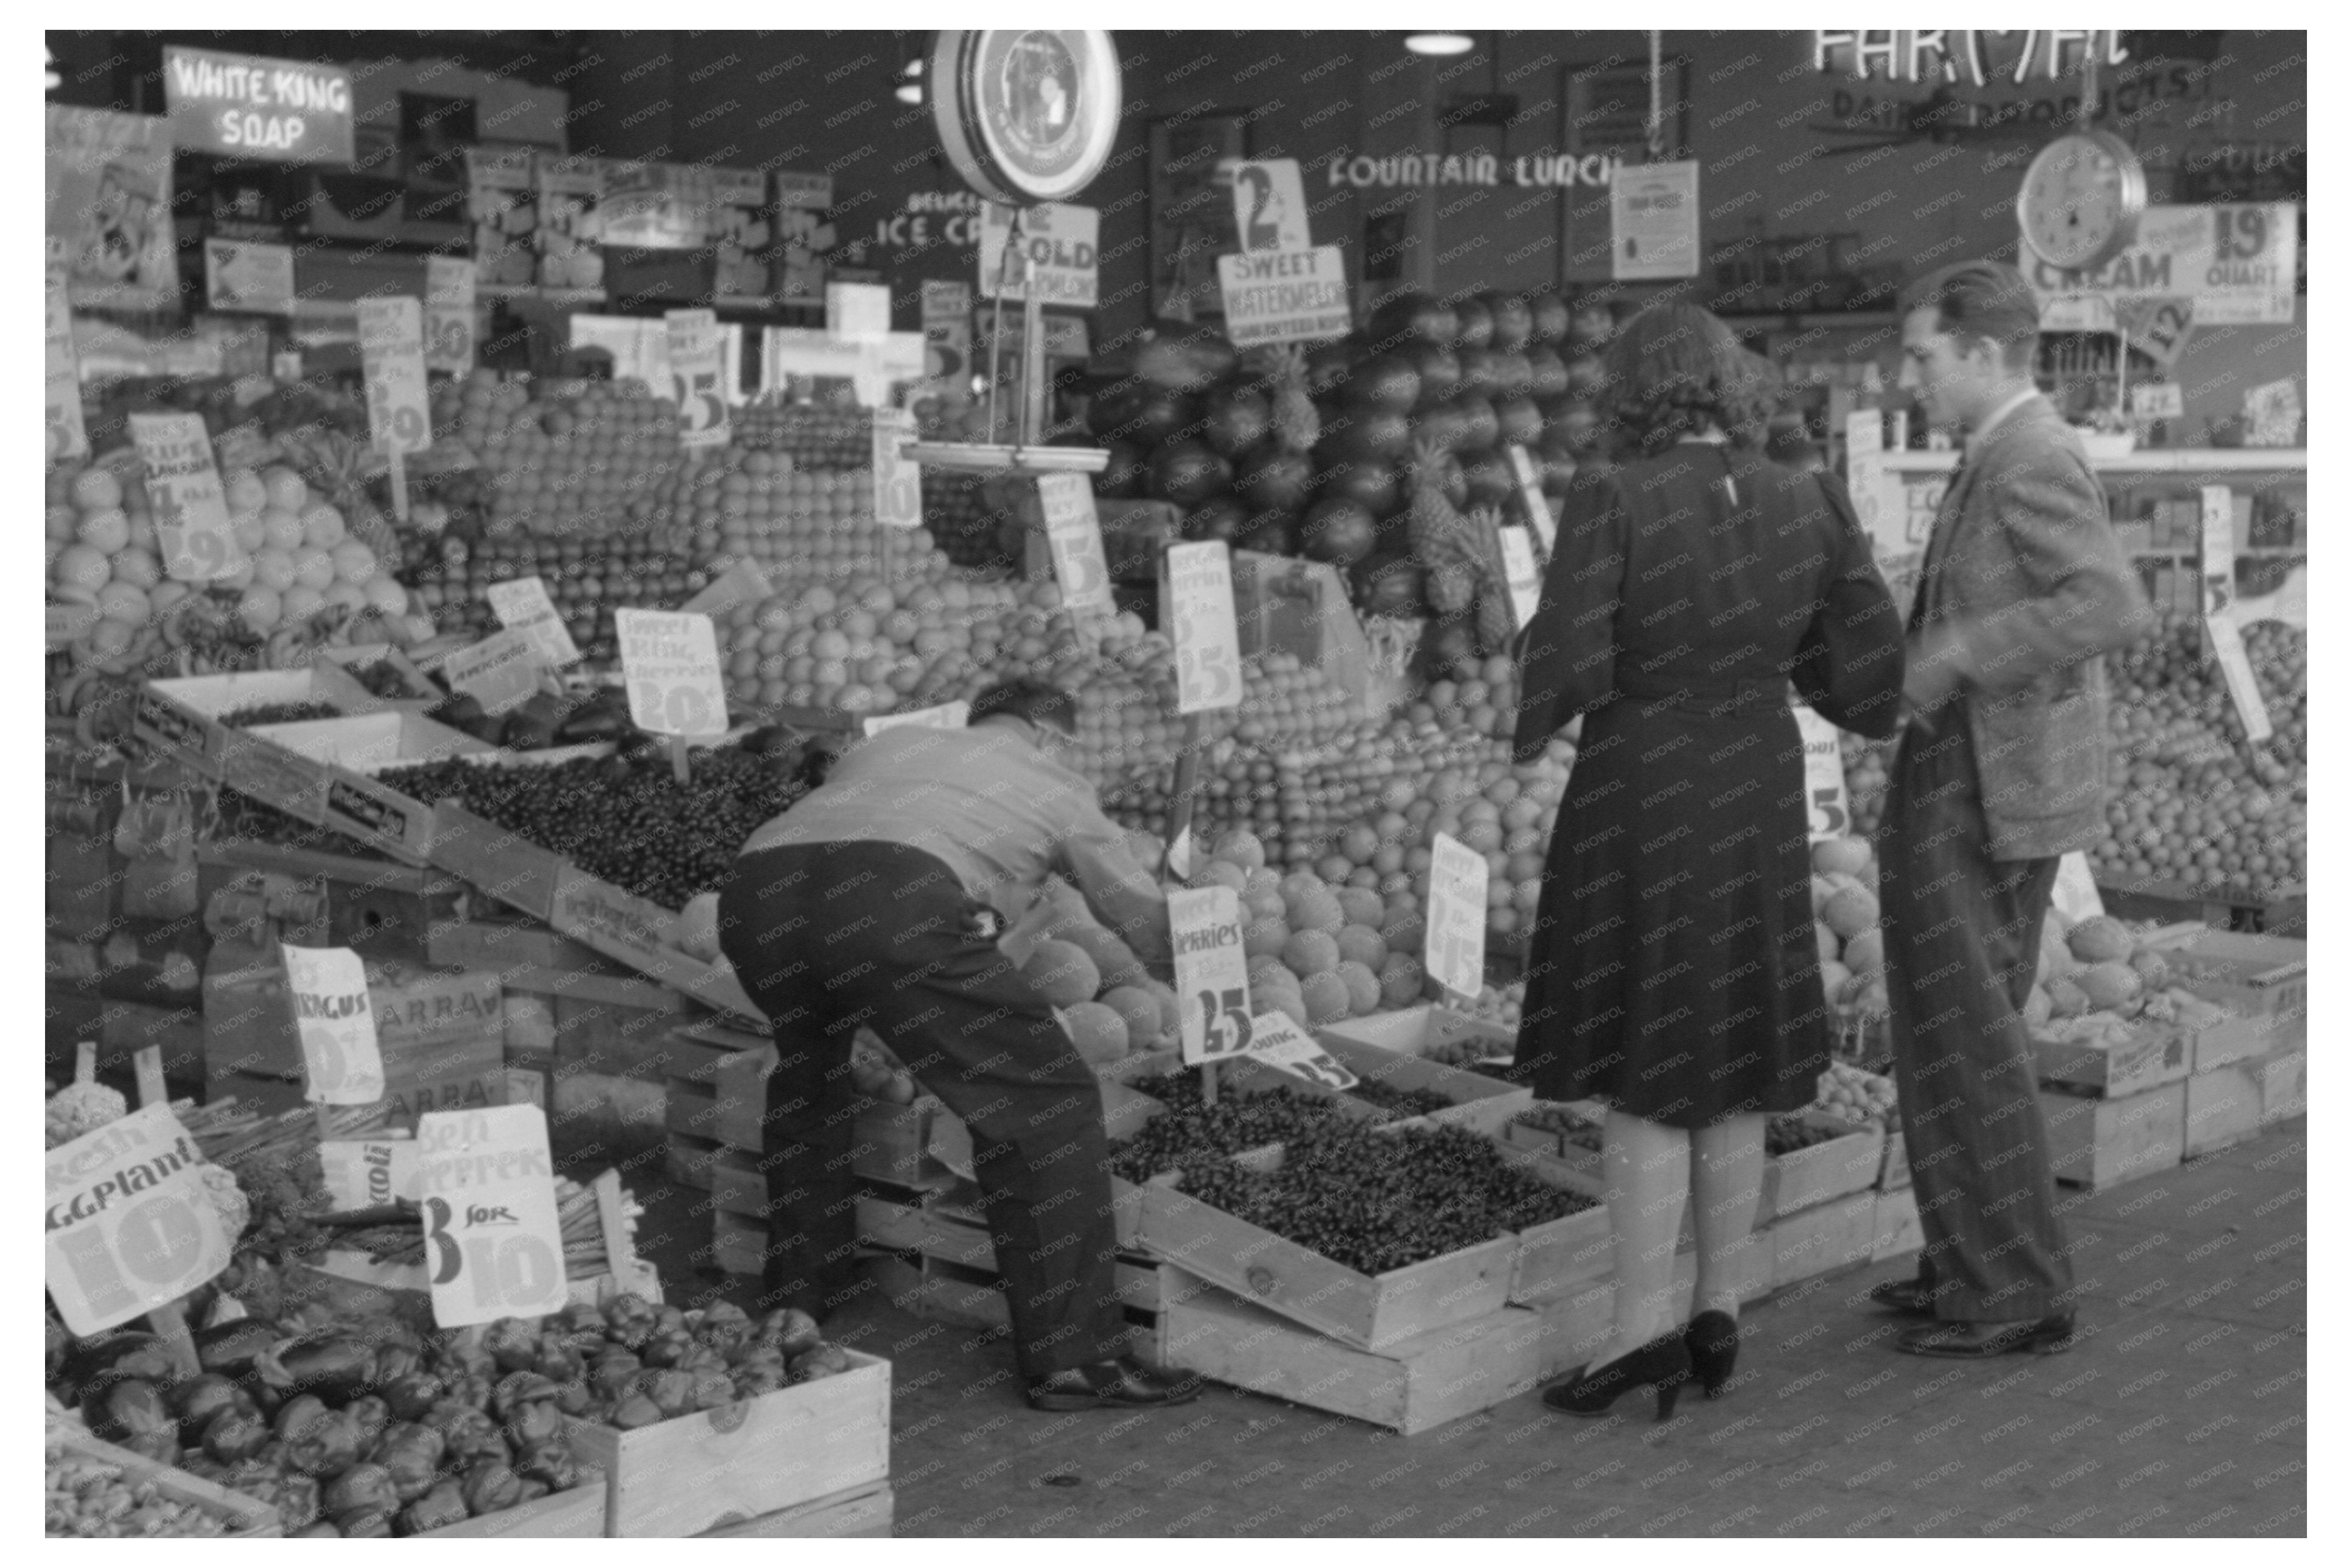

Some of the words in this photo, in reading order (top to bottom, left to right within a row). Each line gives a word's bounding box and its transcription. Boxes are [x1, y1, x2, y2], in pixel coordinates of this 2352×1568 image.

[173, 55, 271, 104] WHITE
[273, 69, 348, 114] KING
[220, 108, 306, 149] SOAP
[1329, 154, 1499, 187] FOUNTAIN
[877, 216, 929, 246] ICE
[1237, 165, 1281, 249] 2
[1030, 236, 1094, 270] OLD
[2214, 207, 2268, 261] 19
[1234, 251, 1317, 279] SWEET
[2205, 265, 2278, 287] QUART
[637, 681, 710, 731] 20
[1197, 987, 1253, 1055] 25
[54, 1195, 203, 1320] 10
[425, 1196, 463, 1285] 3
[463, 1233, 559, 1308] 10
